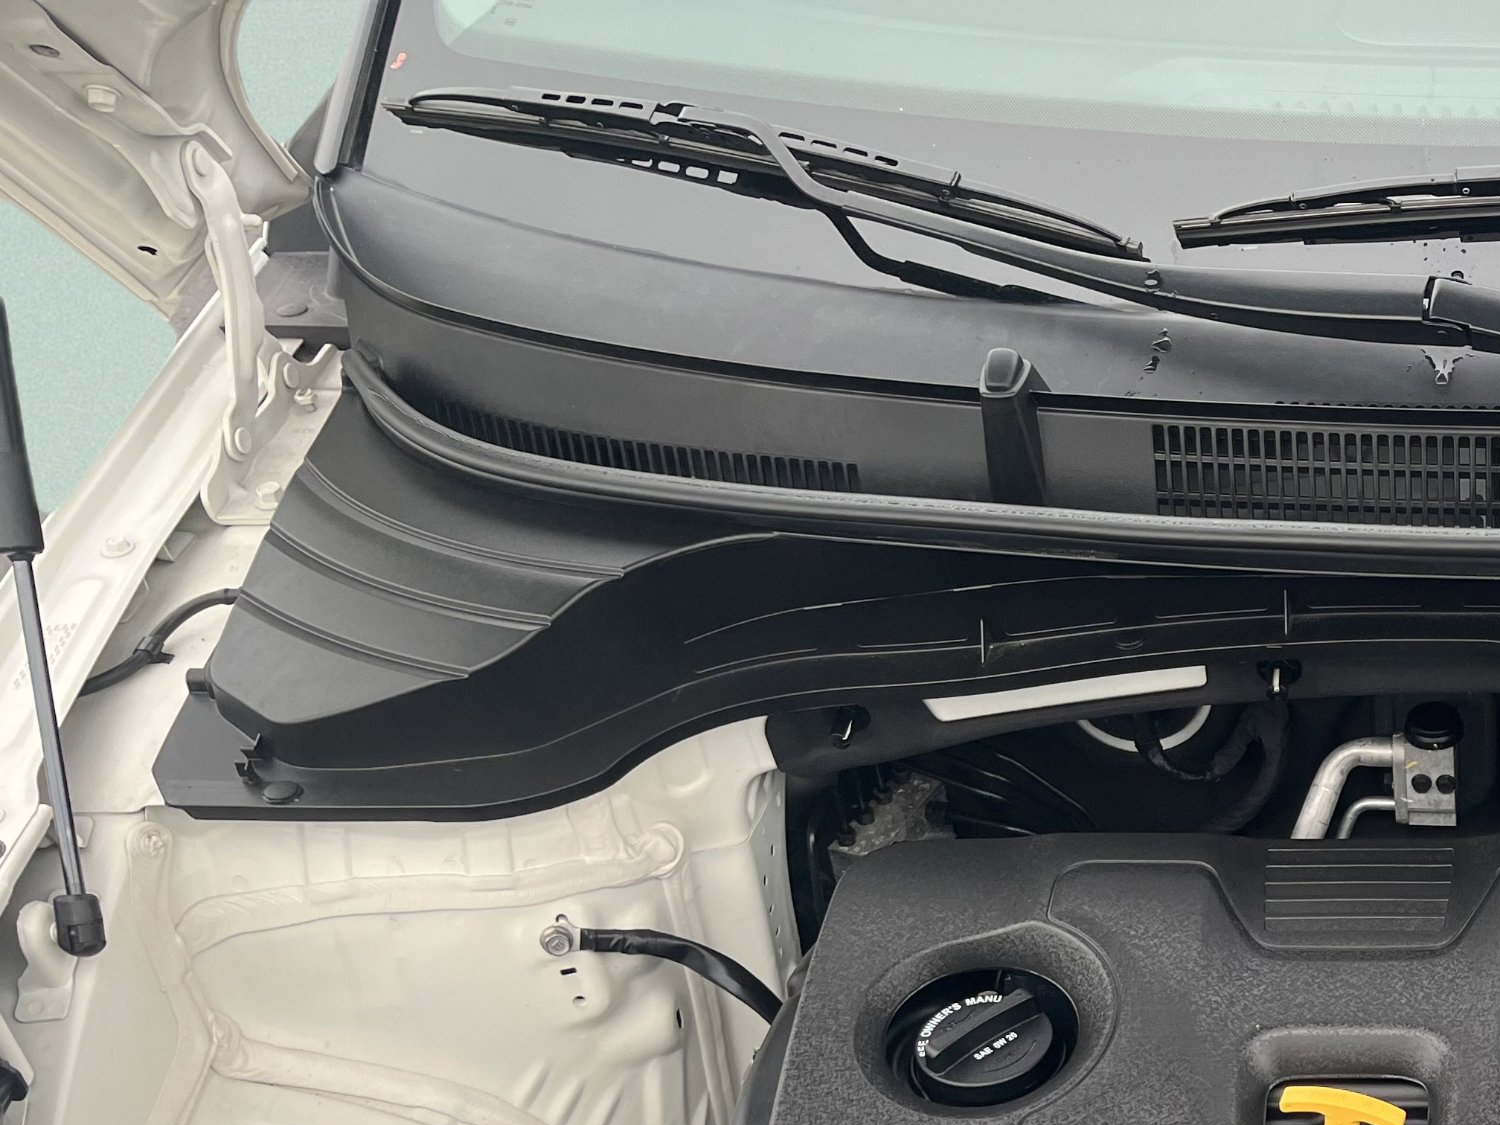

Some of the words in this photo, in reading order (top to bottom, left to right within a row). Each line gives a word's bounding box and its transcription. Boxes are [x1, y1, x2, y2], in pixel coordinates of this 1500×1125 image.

[920, 1002, 962, 1038] OWNER'S
[965, 994, 1003, 1007] MANU
[973, 1046, 994, 1060] SAE
